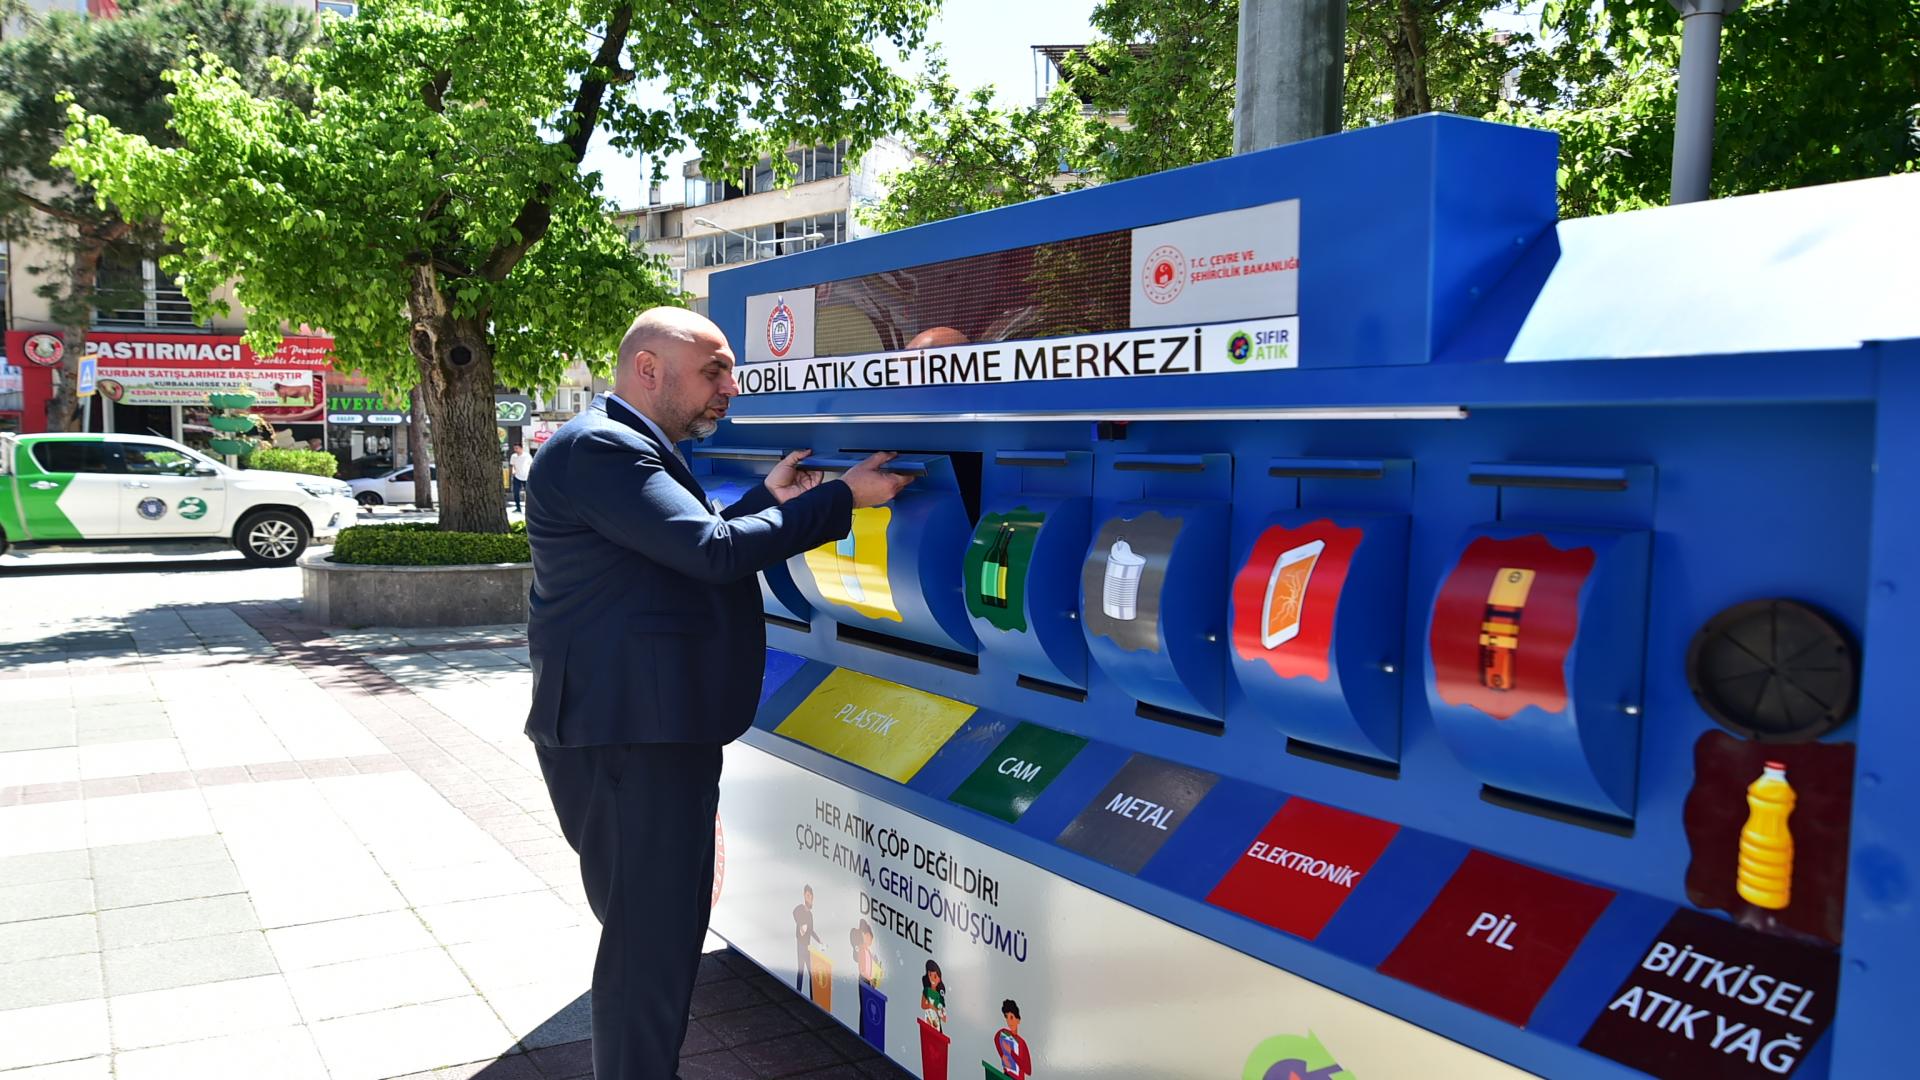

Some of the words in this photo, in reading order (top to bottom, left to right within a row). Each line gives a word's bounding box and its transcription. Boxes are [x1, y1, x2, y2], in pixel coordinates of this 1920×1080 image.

[1210, 252, 1239, 267] ÇEVRE
[1242, 250, 1254, 260] VE
[85, 341, 241, 361] PASTIRMACI
[1256, 329, 1289, 345] SIFIR
[1256, 345, 1289, 360] ATIK
[97, 369, 145, 377] KURBAN
[148, 370, 226, 379] SATIŞLARIMIZ
[229, 371, 302, 381] BAŞLAMIŞTIR
[802, 361, 857, 390] ATIK
[863, 350, 1001, 386] GETİRME
[1014, 328, 1202, 380] MERKEZİ
[835, 704, 900, 737] PLASTİK
[997, 757, 1043, 783] CAM
[1105, 793, 1174, 831] METAL
[815, 798, 841, 833] HER
[844, 813, 875, 847] ATIK
[878, 828, 910, 861] ÇÖP
[913, 843, 999, 907] DEĞİLDİR!
[1247, 841, 1361, 888] ELEKTRONİK
[795, 823, 829, 860] ÇÖPE
[832, 842, 875, 887] ATMA,
[879, 867, 913, 904] GERİ
[917, 885, 1028, 963] DÖNÜŞÜMÜ
[860, 892, 933, 954] DESTEKLE
[1466, 912, 1516, 951] PİL
[1641, 941, 1816, 1025] BİTKİSEL
[1608, 985, 1709, 1040] ATIK
[1710, 1014, 1803, 1075] YAĞ
